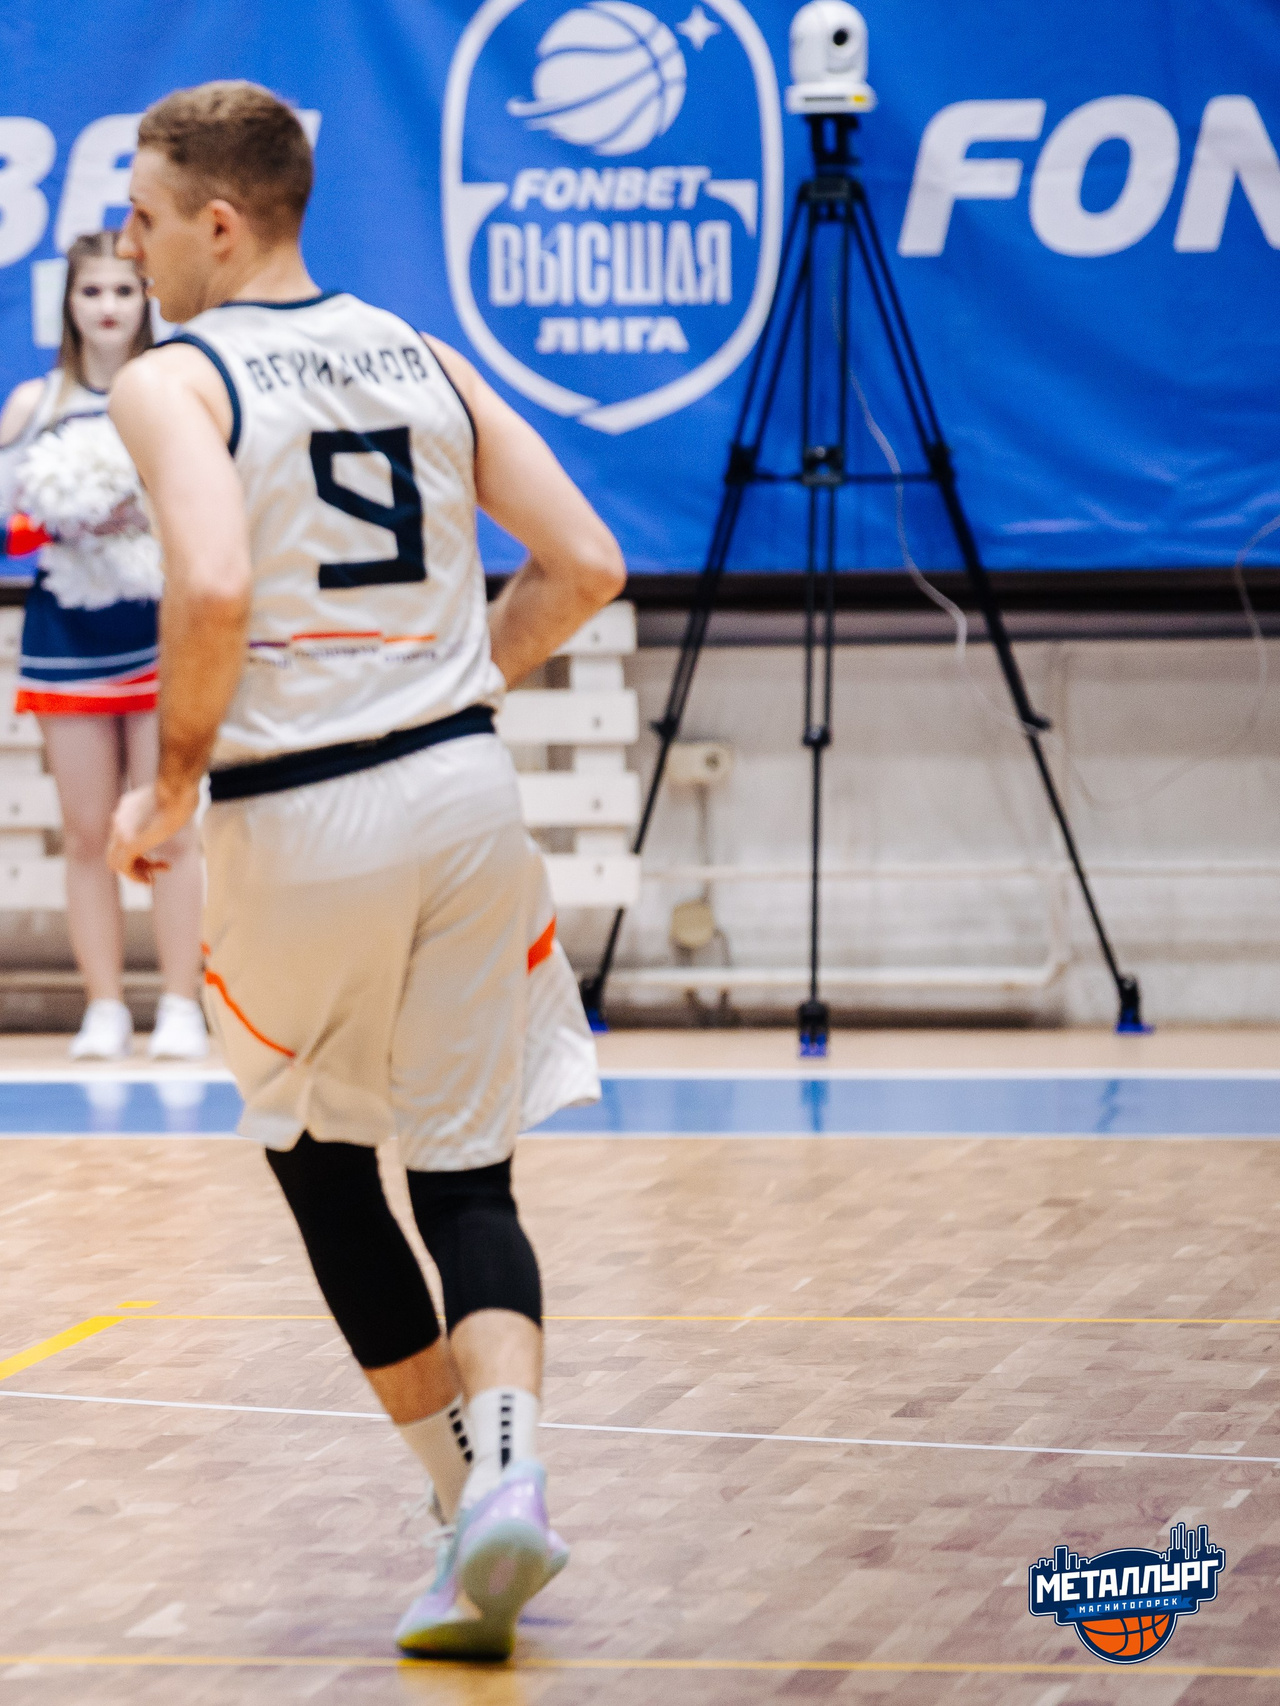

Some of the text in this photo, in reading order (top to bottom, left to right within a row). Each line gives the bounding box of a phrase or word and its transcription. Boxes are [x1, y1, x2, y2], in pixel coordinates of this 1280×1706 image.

[510, 166, 712, 212] FONBET
[488, 220, 733, 307] ВЫСШАЯ
[536, 315, 690, 354] ЛИГА
[309, 426, 428, 590] 9
